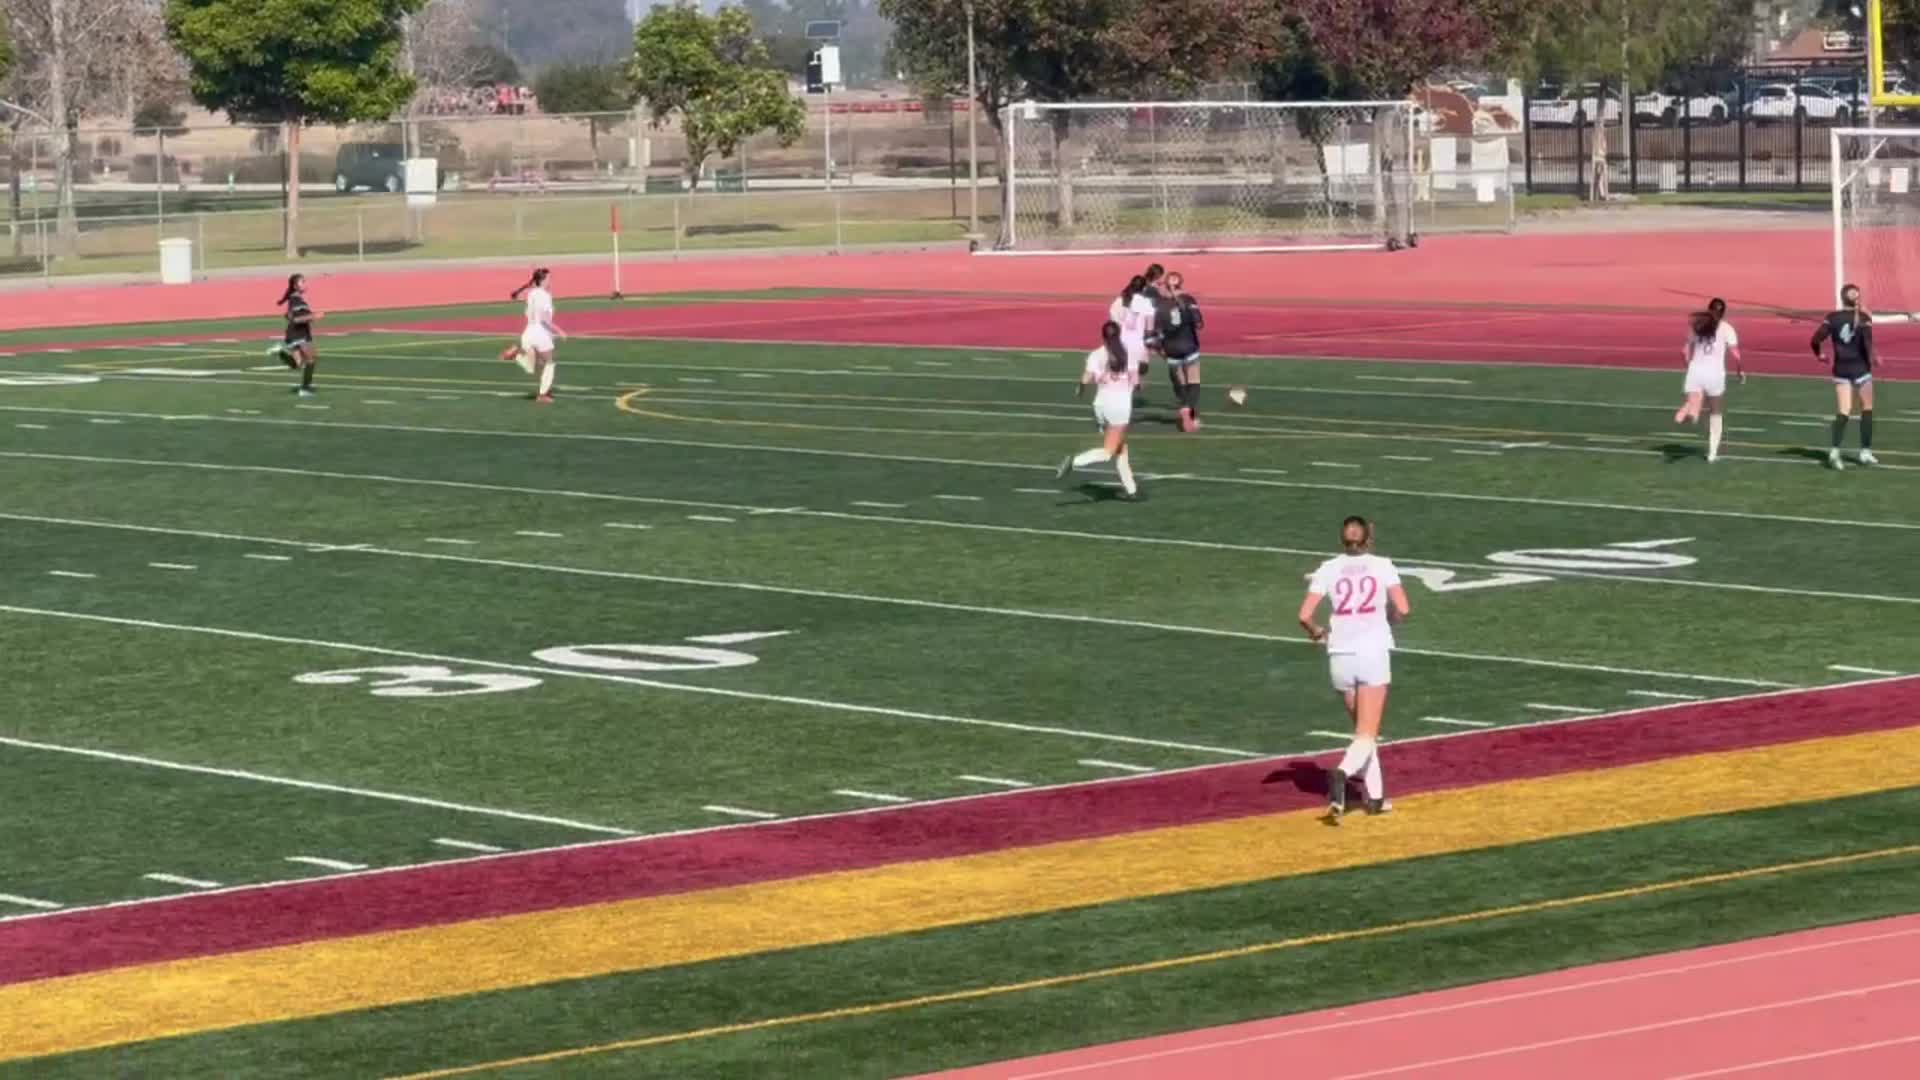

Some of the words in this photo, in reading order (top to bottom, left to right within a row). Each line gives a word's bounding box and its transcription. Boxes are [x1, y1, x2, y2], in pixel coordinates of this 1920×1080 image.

[1840, 323, 1855, 344] 4
[1335, 576, 1377, 616] 22
[293, 644, 760, 697] 30
